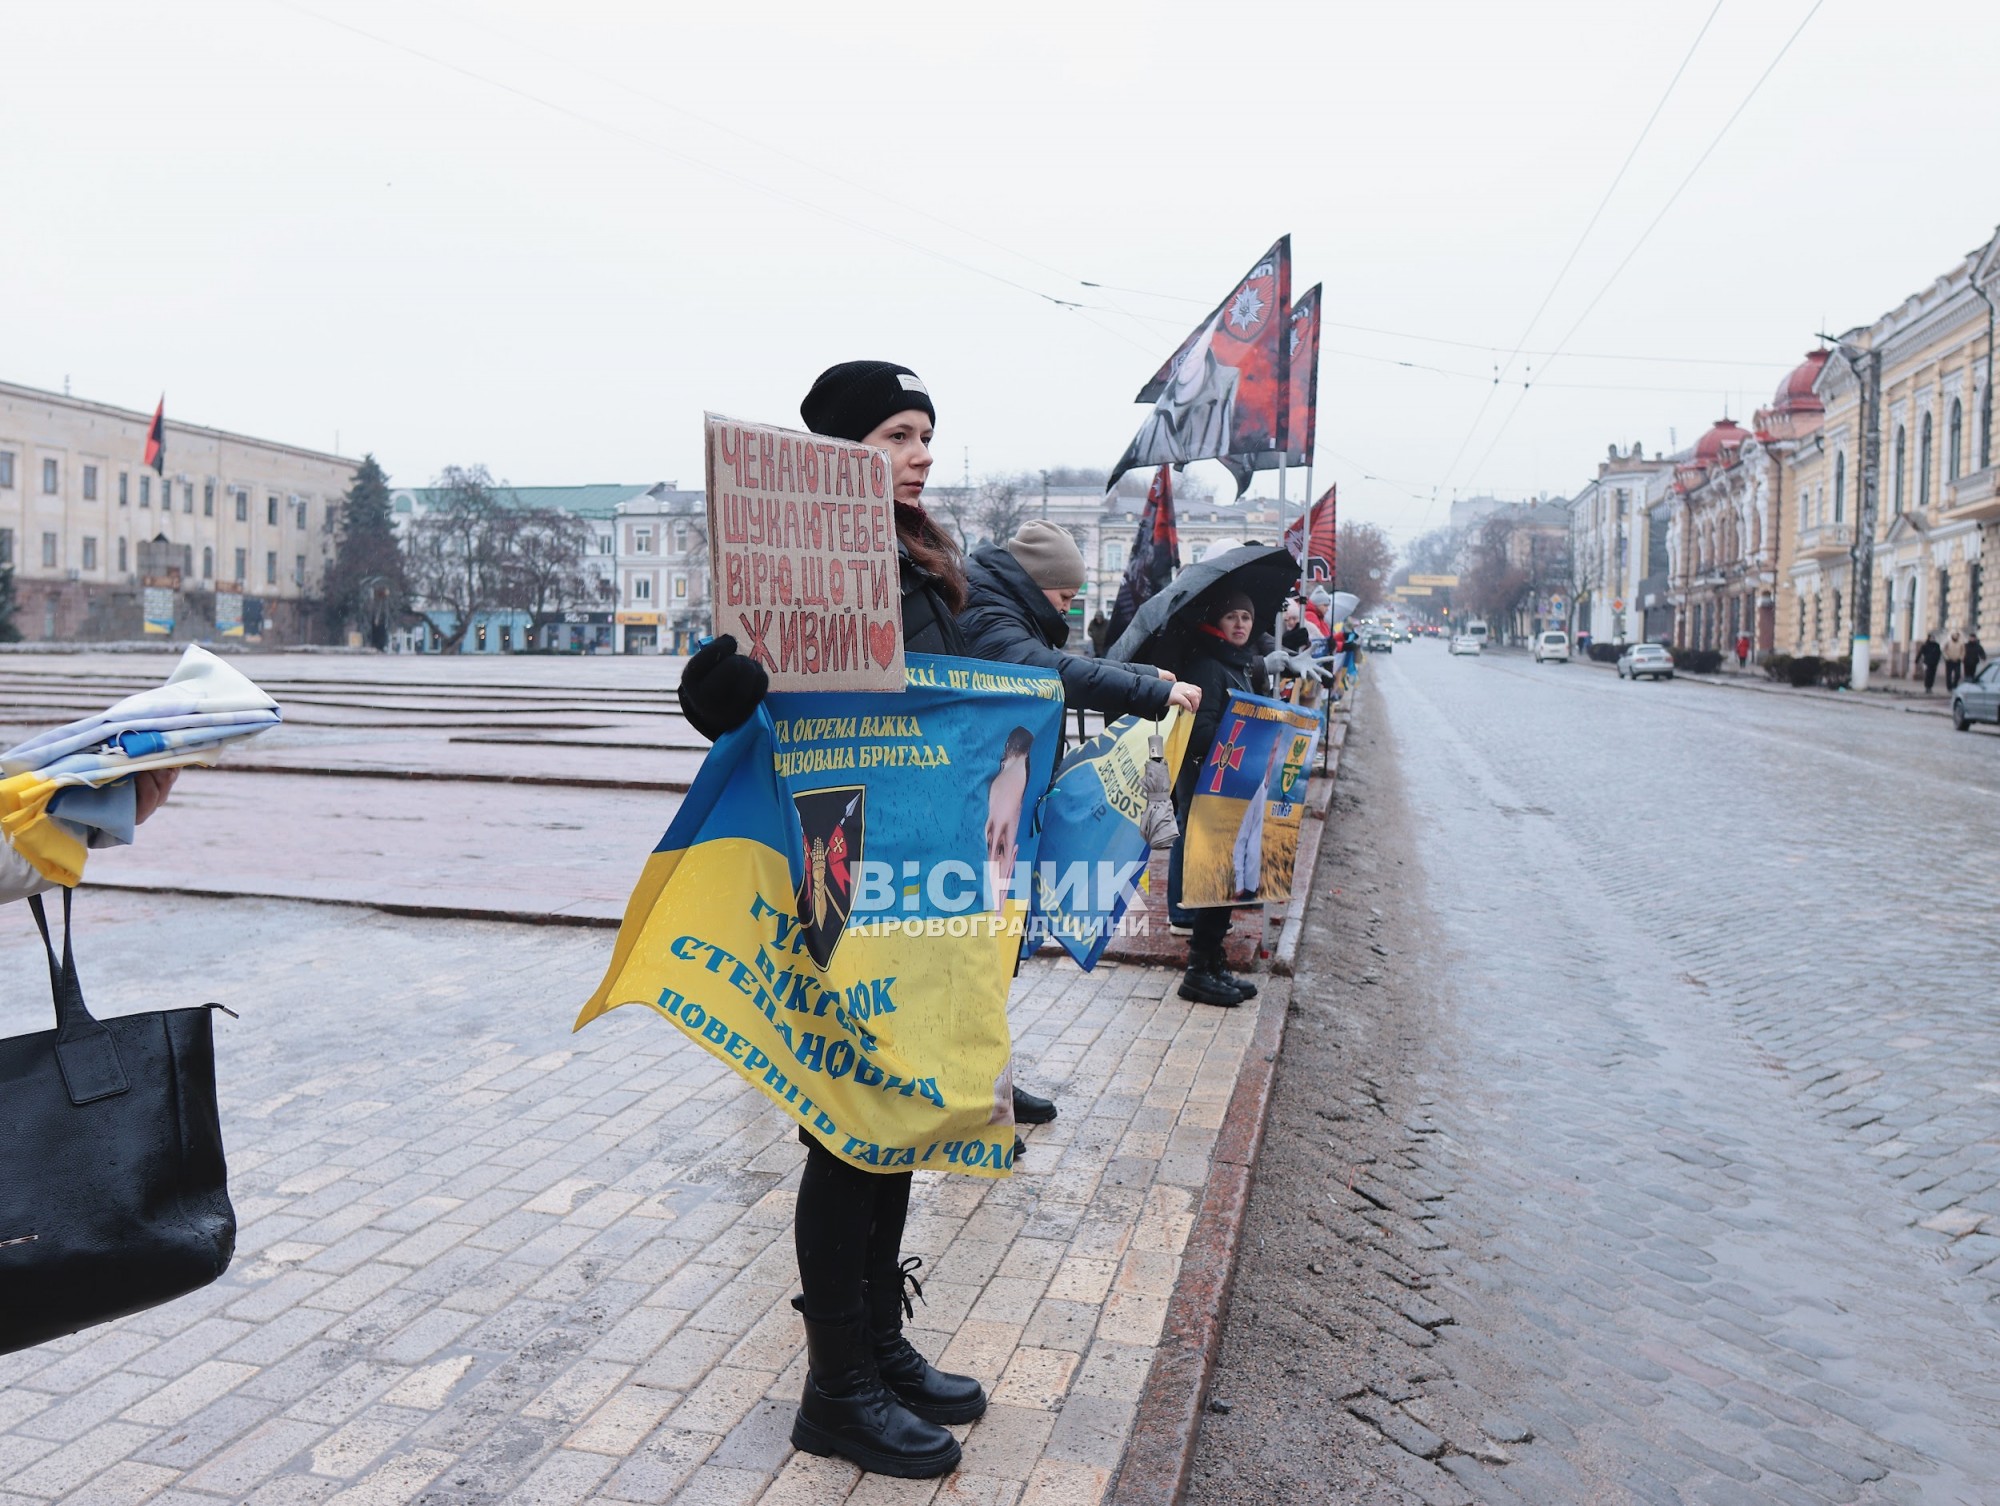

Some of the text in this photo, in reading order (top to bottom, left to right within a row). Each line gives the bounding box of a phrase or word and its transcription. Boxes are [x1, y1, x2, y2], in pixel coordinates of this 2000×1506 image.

[848, 560, 888, 610] ТИ
[793, 717, 856, 744] ОКРЕМА
[859, 716, 923, 738] ВАЖКА
[774, 745, 951, 778] НІЗОВАНА БРИГАДА
[656, 987, 836, 1136] ПОВЕРНІТЬ
[841, 1132, 916, 1167] ТАТА
